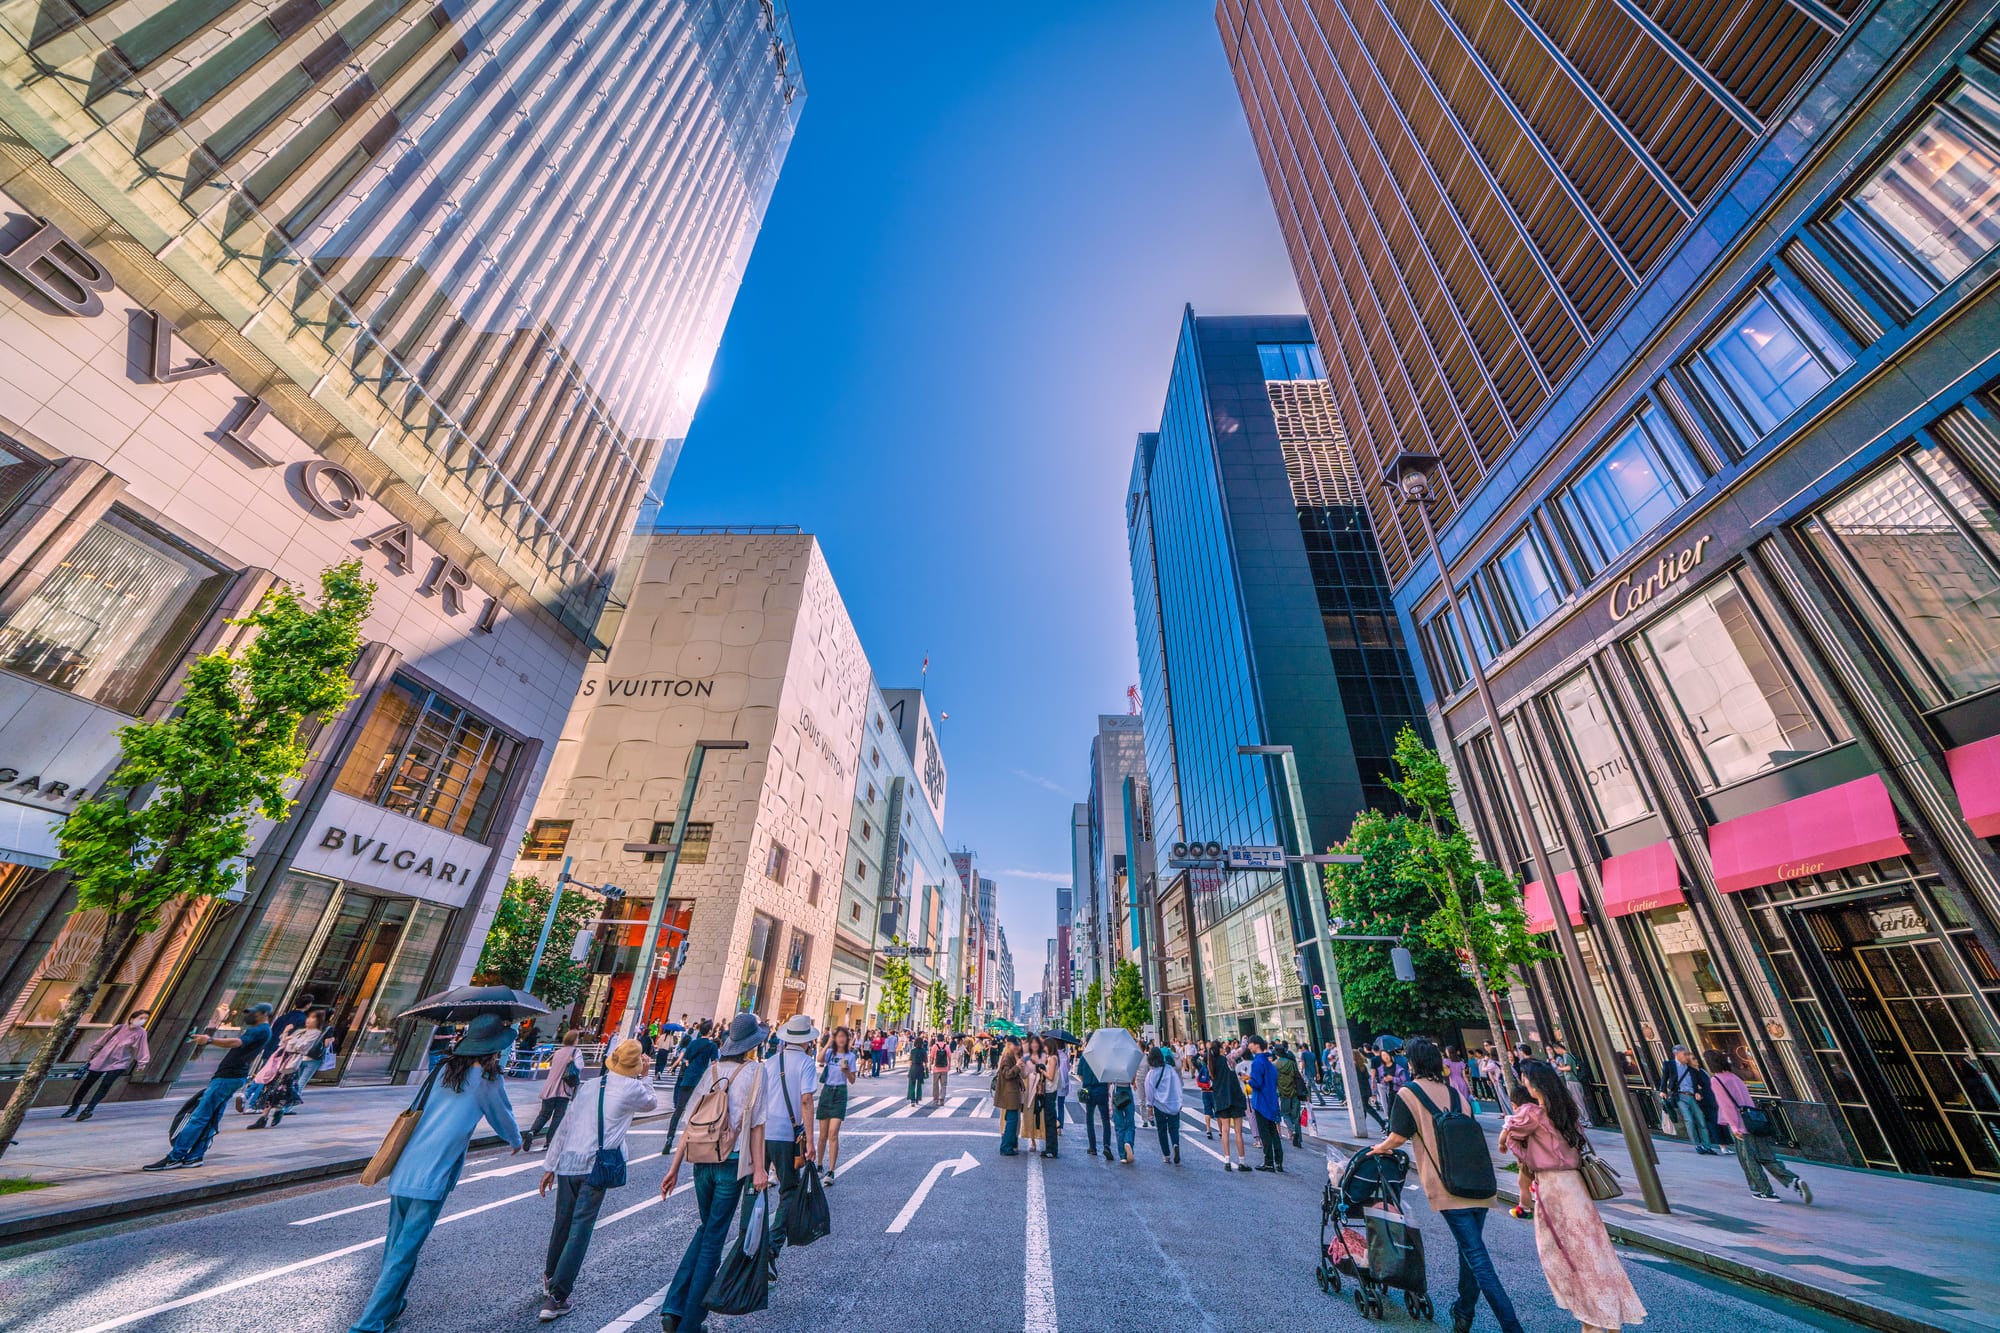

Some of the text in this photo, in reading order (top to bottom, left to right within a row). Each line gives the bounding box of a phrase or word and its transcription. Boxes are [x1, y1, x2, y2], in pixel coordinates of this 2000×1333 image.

[0, 215, 501, 634] BVLGARI
[1609, 535, 1710, 621] Cartier
[607, 680, 714, 698] VUITTON
[800, 709, 844, 781] LOUIS VUITTON
[319, 826, 471, 886] BVLGARI
[1777, 861, 1825, 880] Cartier
[1627, 899, 1658, 913] Cartier
[1868, 911, 1930, 933] Cartier
